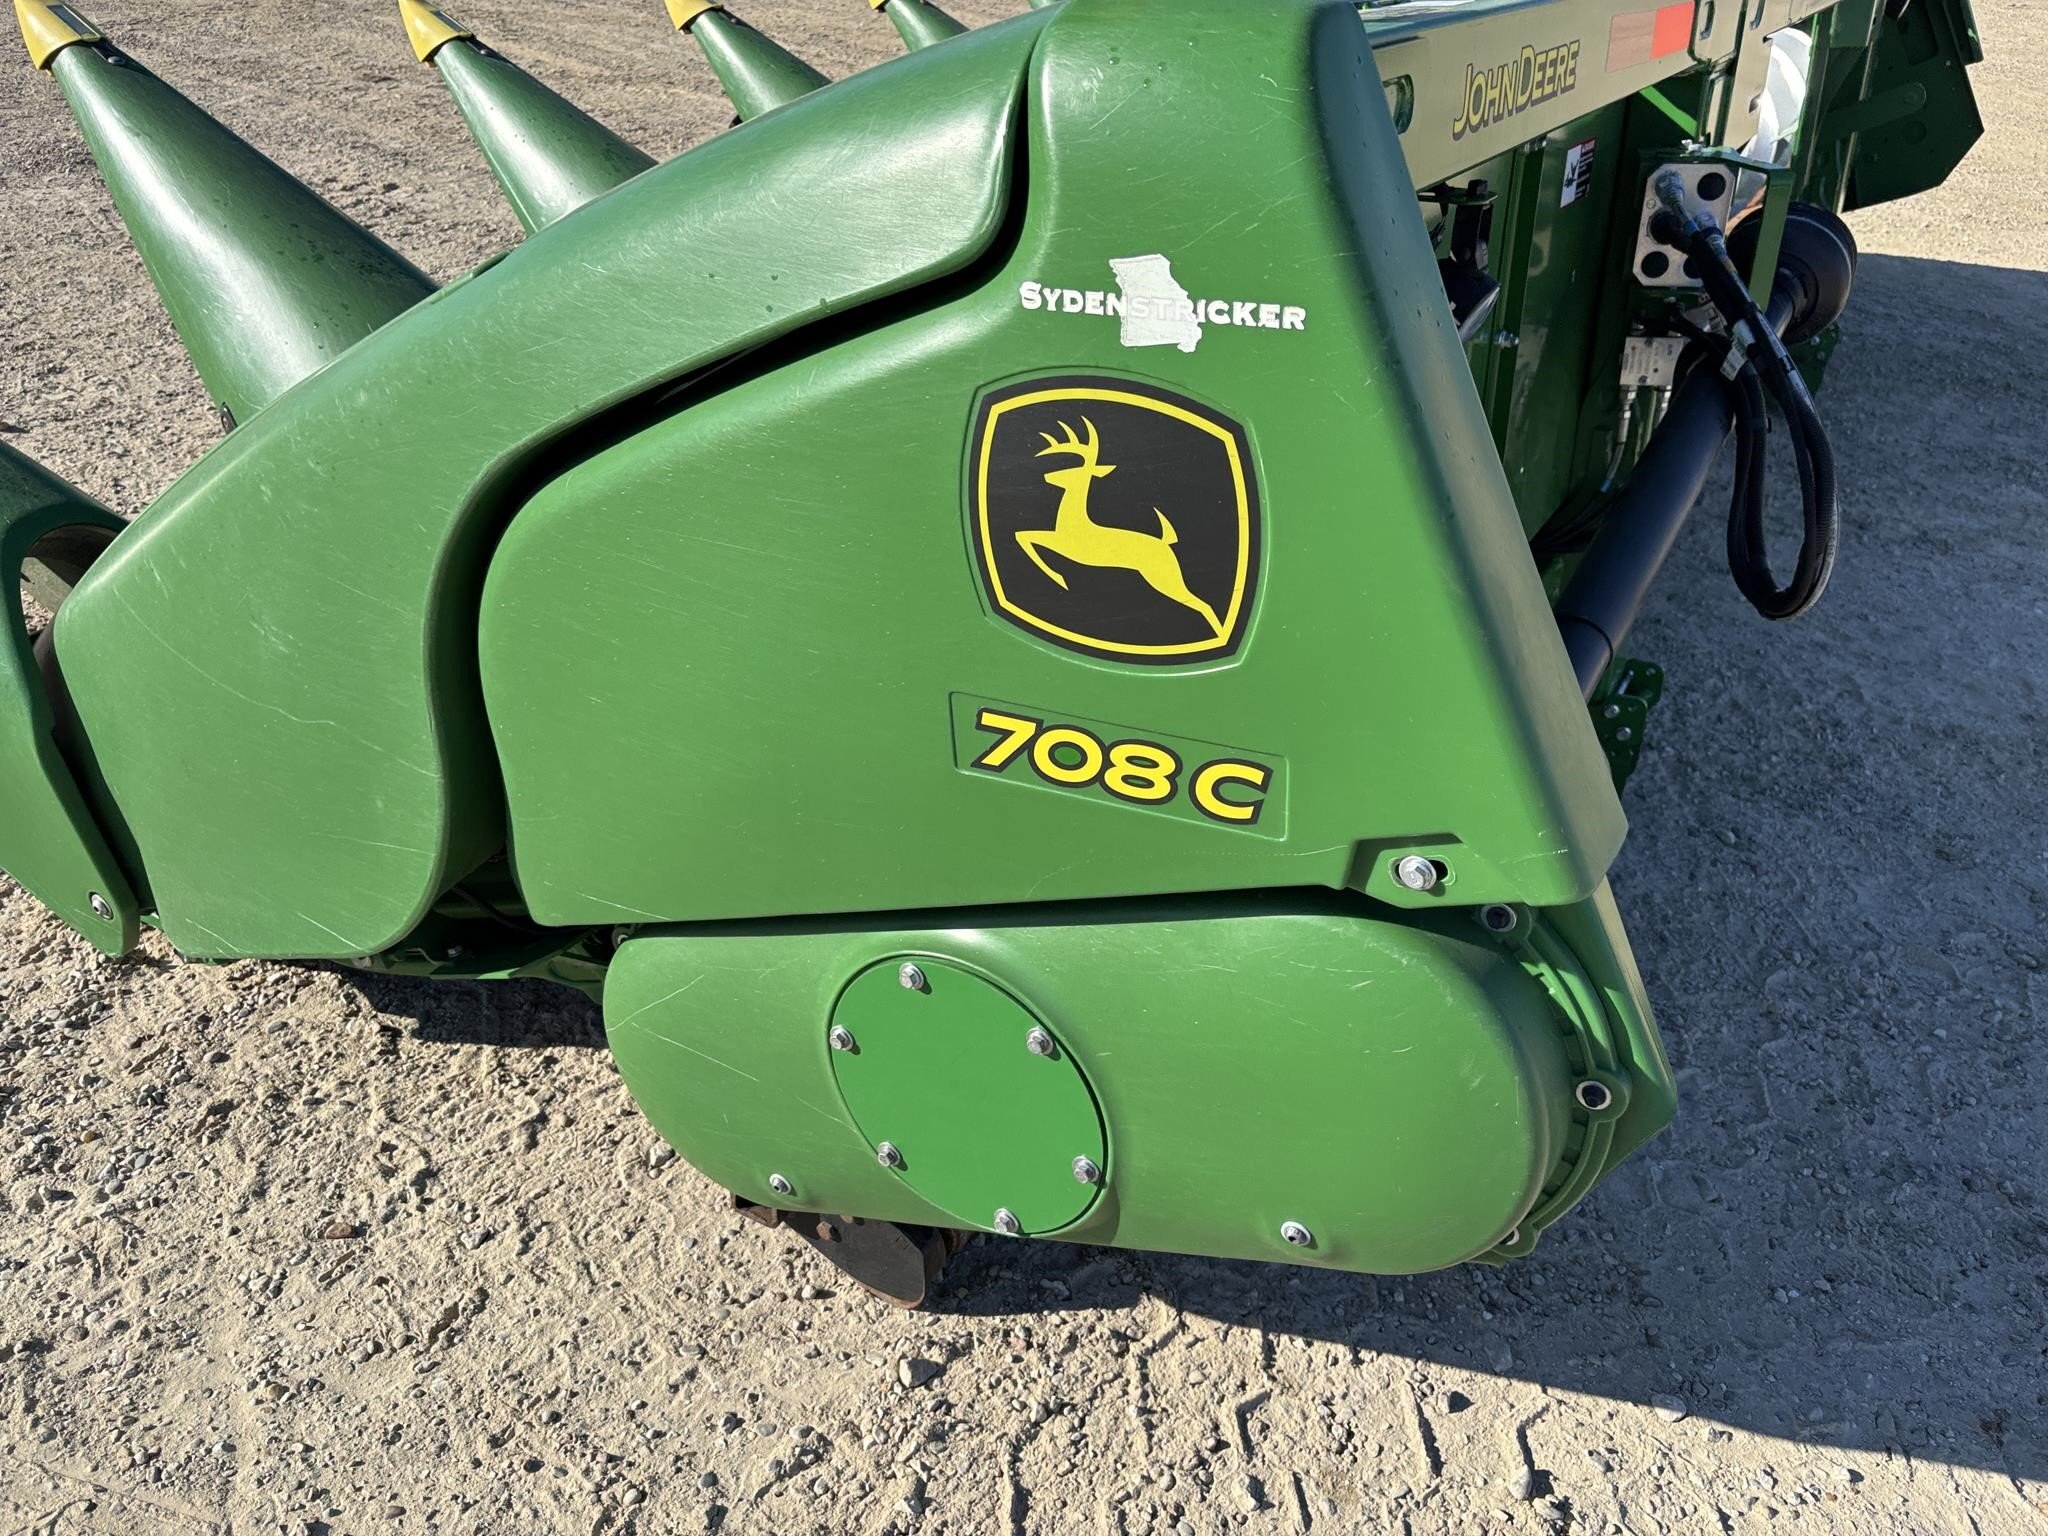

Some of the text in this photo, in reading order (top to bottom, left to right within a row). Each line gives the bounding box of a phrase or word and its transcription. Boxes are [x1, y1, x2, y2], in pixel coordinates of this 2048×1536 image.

[1019, 281, 1307, 331] SYDENSTRICKER
[970, 707, 1274, 825] 708 C
